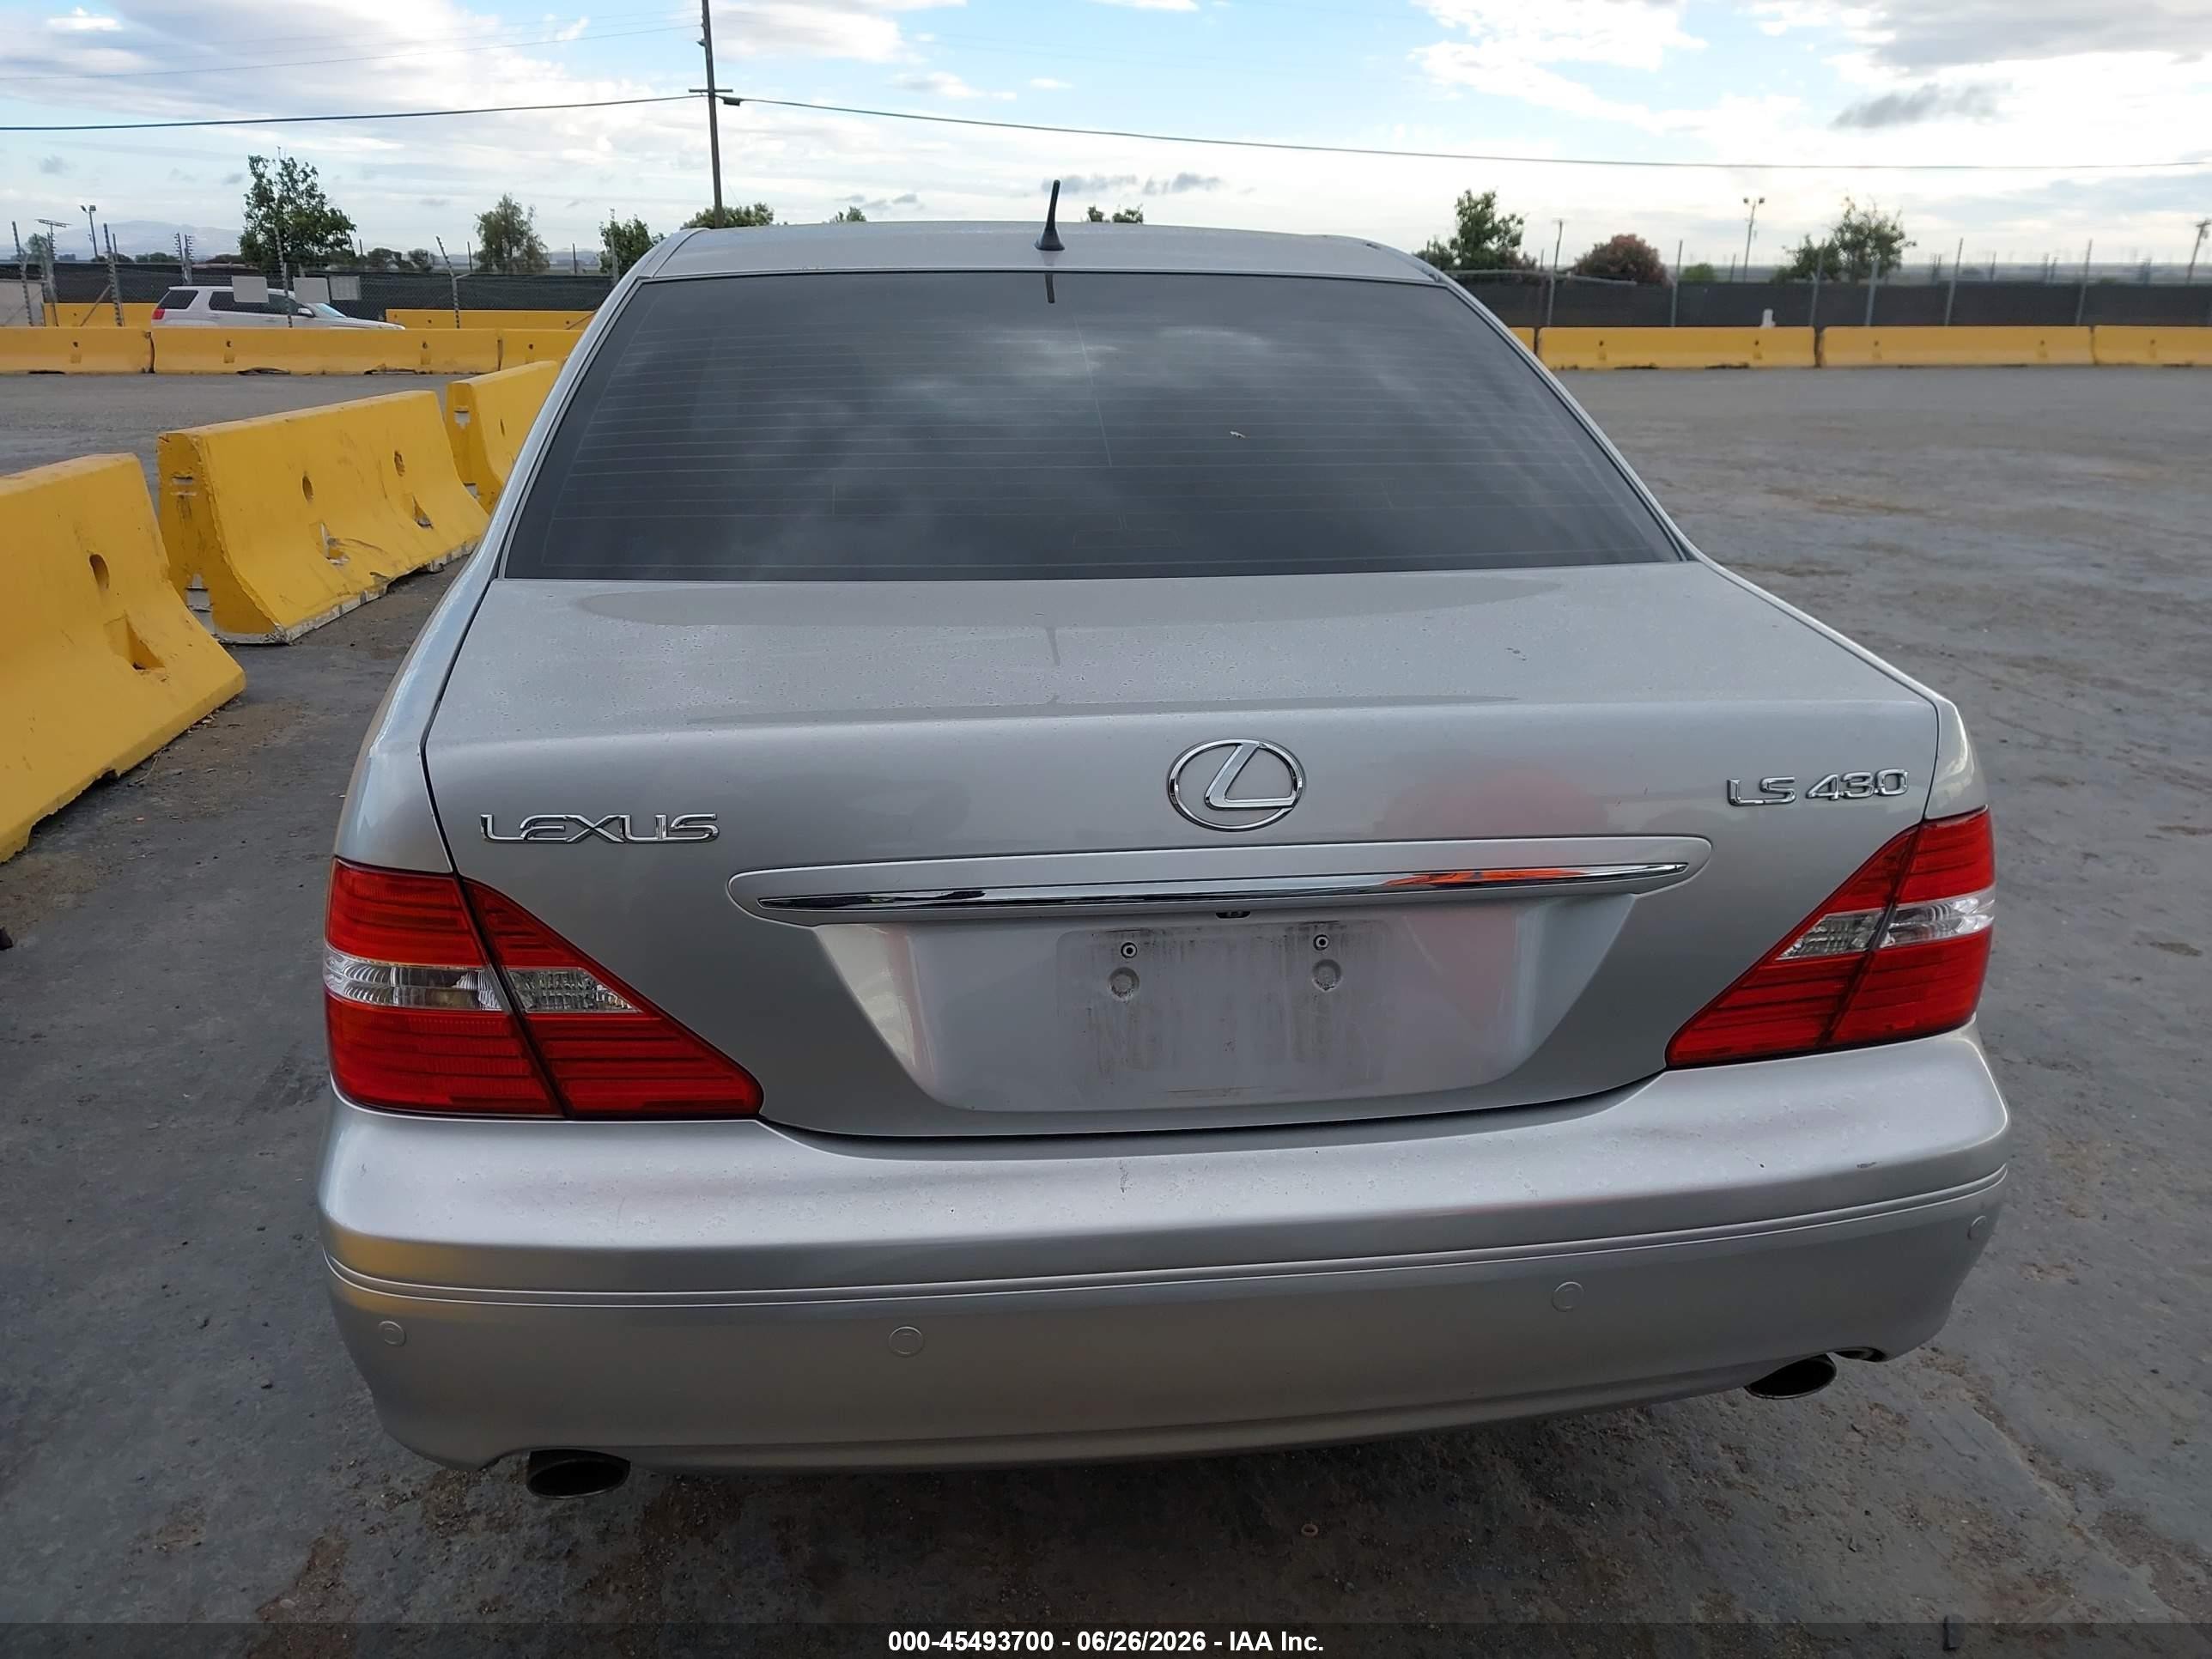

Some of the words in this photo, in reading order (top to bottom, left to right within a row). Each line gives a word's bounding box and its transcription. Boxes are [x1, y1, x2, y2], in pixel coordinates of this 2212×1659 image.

[1726, 776, 1796, 806] LS
[1805, 768, 1910, 800] 430
[479, 813, 720, 843] LEXUS
